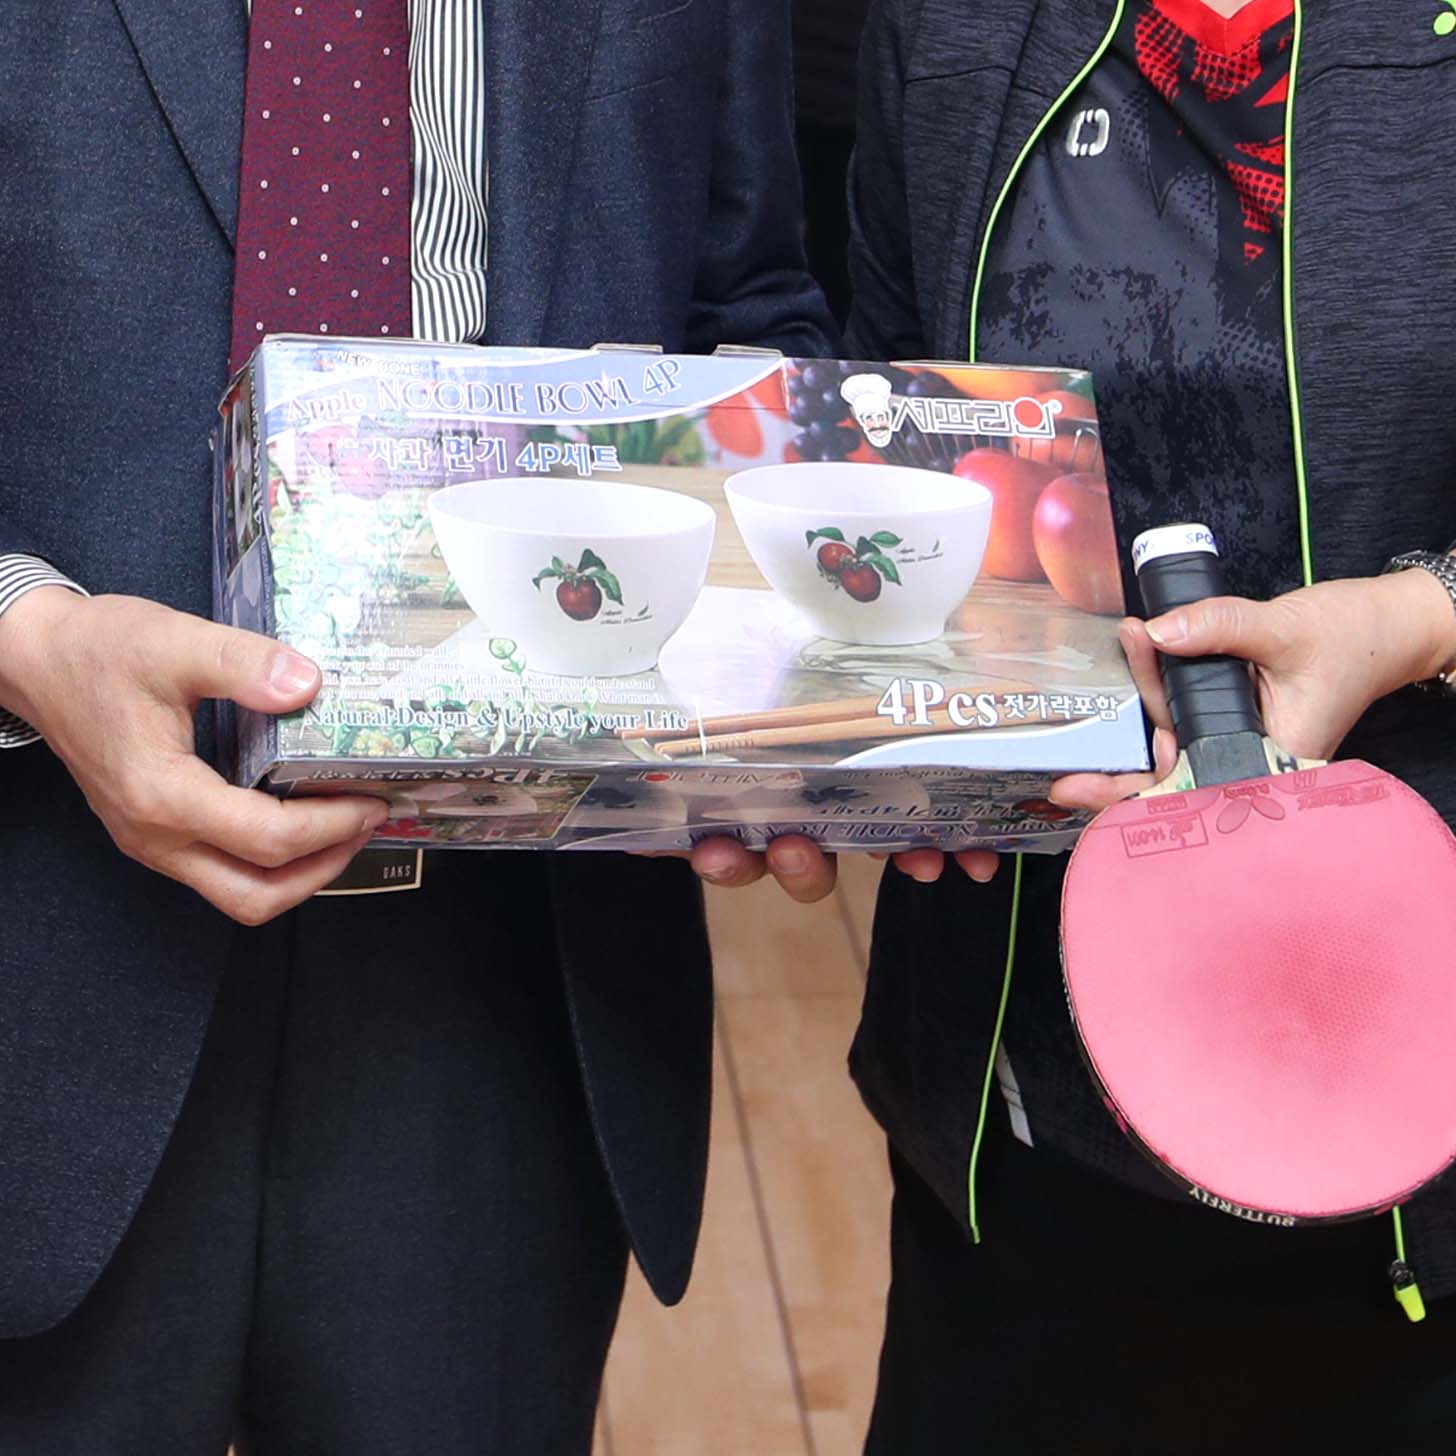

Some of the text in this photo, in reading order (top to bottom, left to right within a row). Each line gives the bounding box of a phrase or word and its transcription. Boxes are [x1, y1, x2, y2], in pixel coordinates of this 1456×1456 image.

[287, 358, 683, 422] Apple NOODLE BOWL 4P
[368, 436, 623, 476] 사과 면기 4P세트
[304, 706, 688, 736] Natural Design & Upstyle your Life
[876, 676, 999, 729] 4Pcs
[1003, 692, 1119, 722] 젓가락포함
[1189, 1186, 1295, 1227] BUTTERFLY
